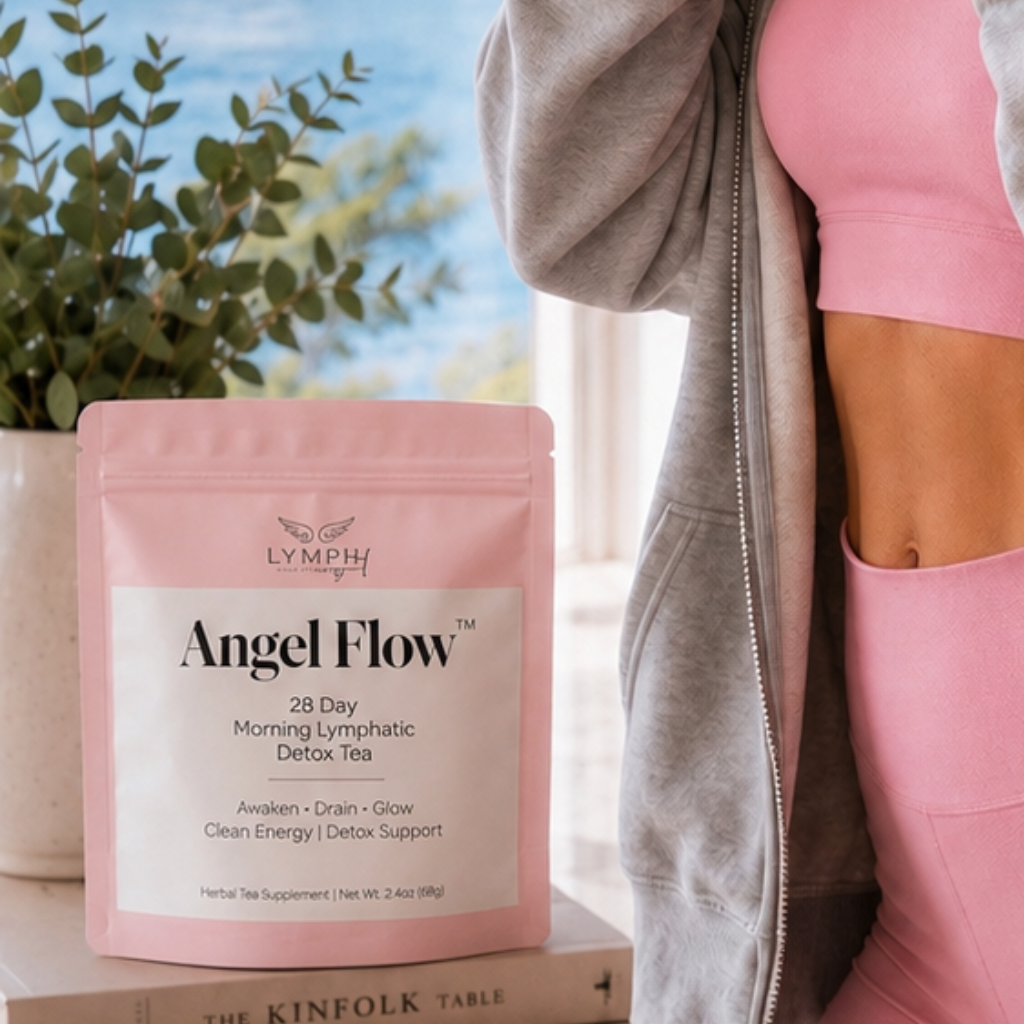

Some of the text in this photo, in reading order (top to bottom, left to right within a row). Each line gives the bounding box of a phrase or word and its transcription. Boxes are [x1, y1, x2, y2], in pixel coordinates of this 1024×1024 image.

[180, 619, 322, 682] Angel
[289, 696, 358, 718] 28 Day
[234, 720, 415, 742] Morning Lymphatic
[277, 744, 372, 761] Detox Tea
[236, 801, 300, 816] Awaken
[314, 801, 358, 816] Drain
[372, 801, 414, 816] Glow
[204, 822, 250, 839] Clean
[255, 824, 314, 844] Energy
[327, 824, 375, 840] Detox
[379, 824, 443, 842] Support
[200, 887, 237, 899] Herbal
[240, 888, 259, 899] Tea
[339, 888, 360, 900] Net
[267, 992, 420, 1024] KINFOLK
[437, 989, 506, 1010] TABLE
